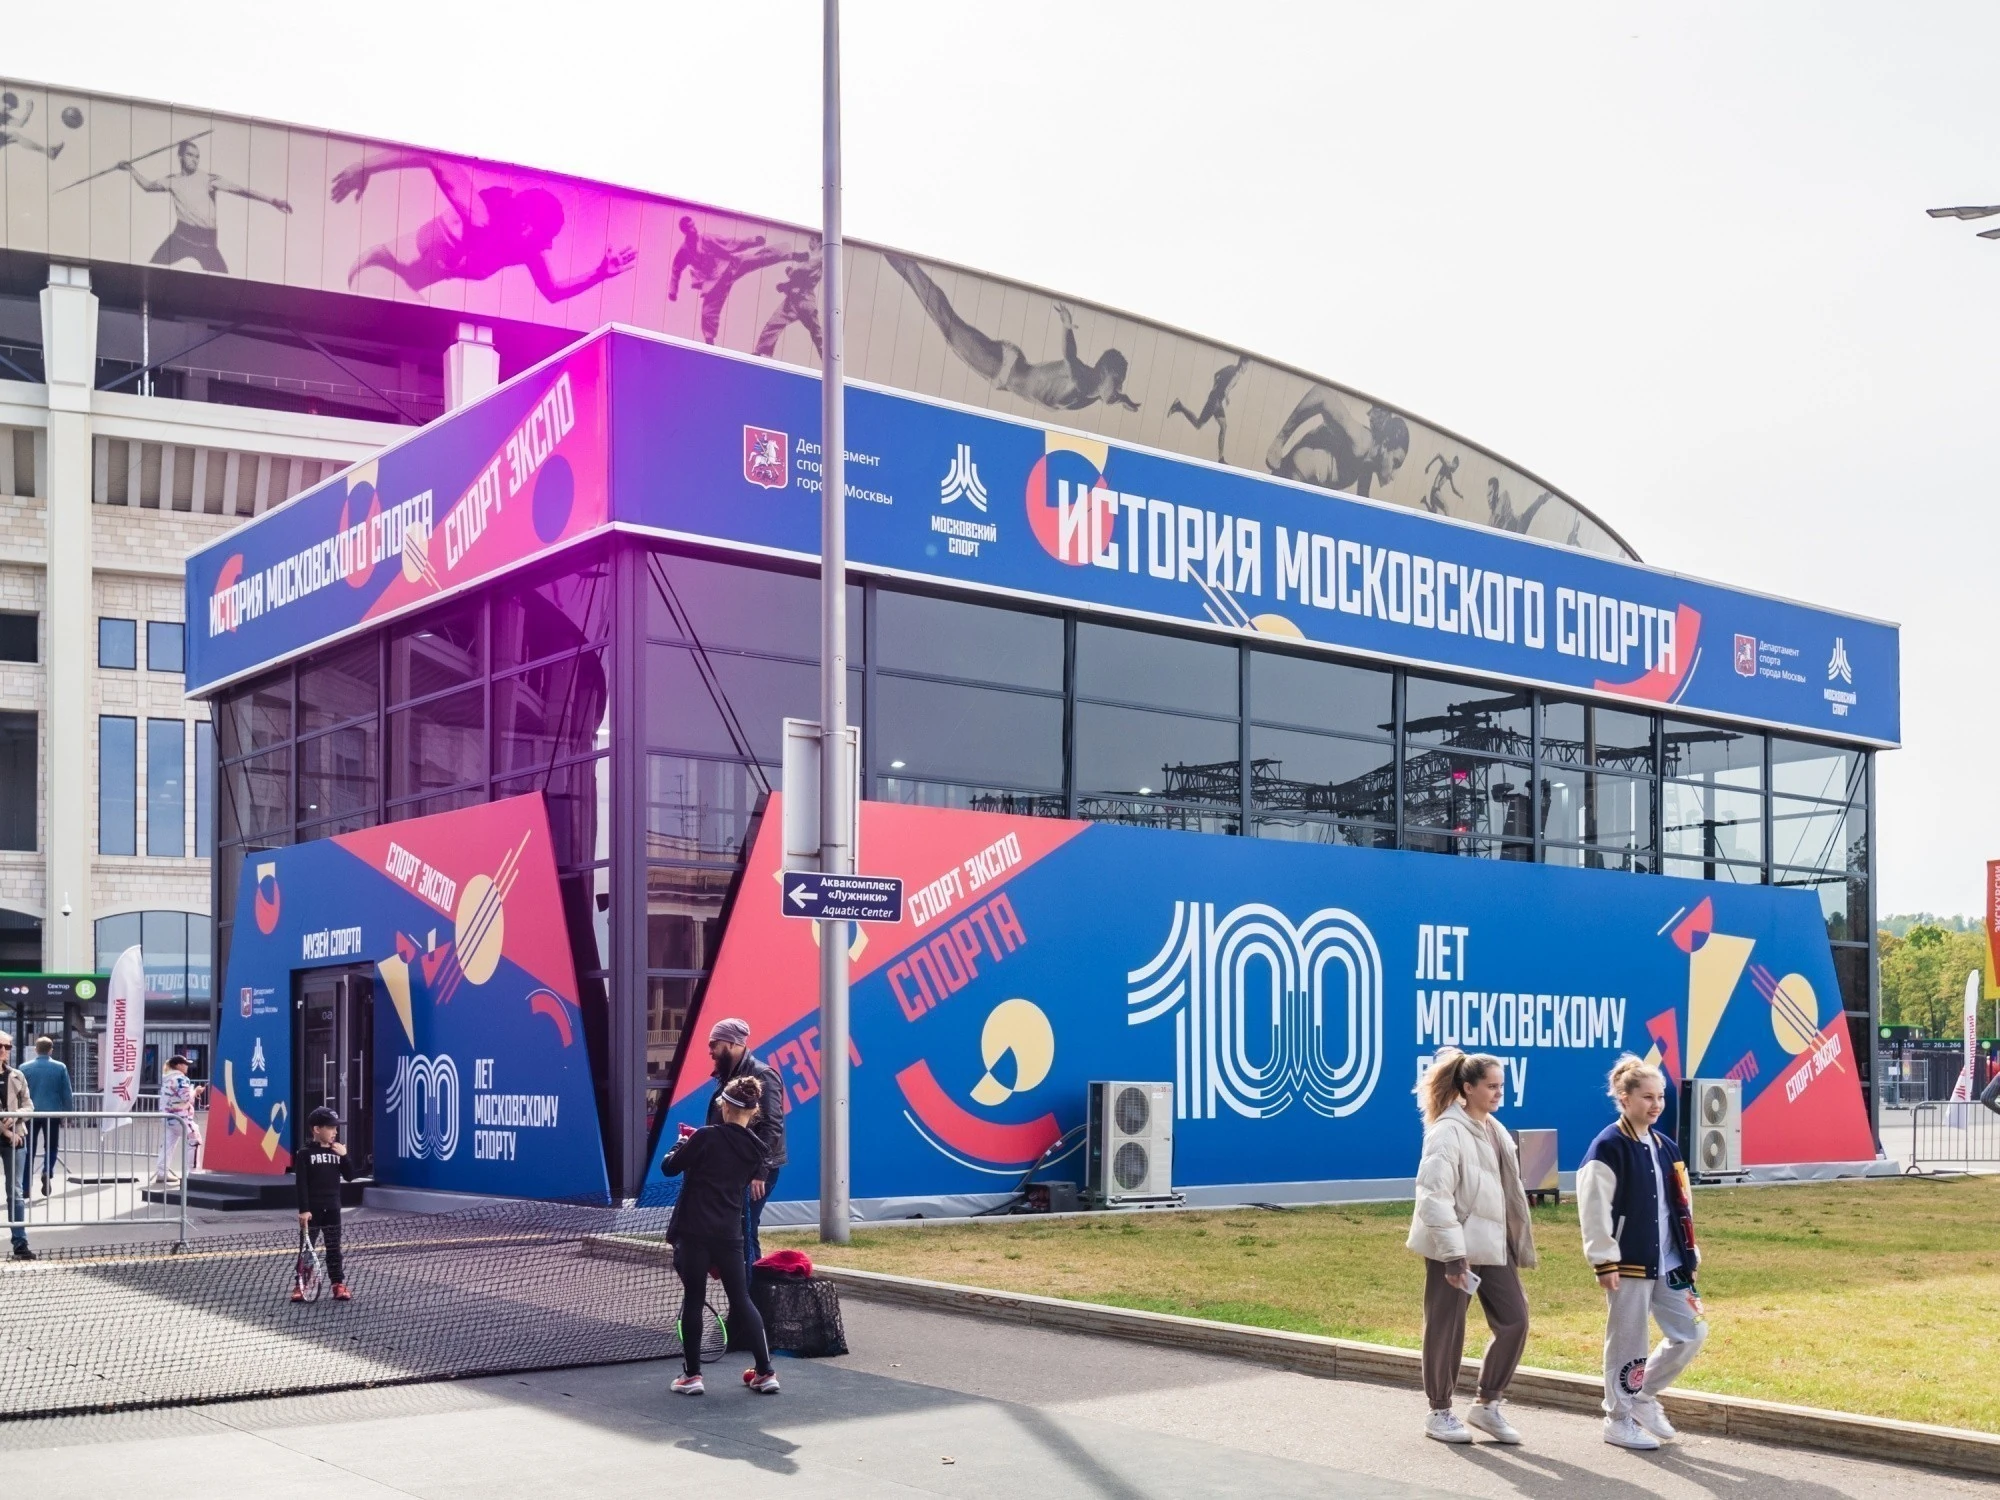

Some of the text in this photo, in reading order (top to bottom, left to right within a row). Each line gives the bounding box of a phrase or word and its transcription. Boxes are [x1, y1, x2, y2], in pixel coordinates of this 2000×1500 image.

[796, 439, 880, 467] Депамент
[445, 371, 575, 571] СПОРТ ЭКСПО
[844, 484, 893, 505] Москвы
[931, 515, 997, 542] МОСКОВСКИЙ
[210, 489, 433, 638] ИСТОРИЯ МОСКОВСКОГО СПОРТА
[949, 537, 979, 557] СПОРТ
[1058, 479, 1676, 675] ИСТОРИЯ МОСКОВСКОГО СПОРТА
[1759, 640, 1799, 657] Департамент
[1759, 655, 1780, 666] спорта
[1759, 668, 1806, 683] города Москвы
[386, 842, 456, 912] СПОРТ ЭКСПО
[820, 877, 896, 890] Аквакомплекс
[908, 832, 1022, 927] СПОРТ ЭКСПО
[822, 905, 893, 918] Aquatic Center
[828, 890, 888, 902] «Лужники»
[303, 926, 361, 960] МУЗЕЙ СПОРТА
[887, 892, 1027, 1022] СПОРТА
[1416, 924, 1469, 981] ЛЕТ
[1128, 901, 1382, 1119] 100
[1416, 989, 1626, 1048] МОСКОВСКОМУ
[113, 998, 126, 1073] МОСКОВСКИЙ
[126, 1038, 137, 1071] СПОРТ
[475, 1059, 494, 1089] ЛЕТ
[1786, 1060, 1813, 1104] СПОРТ
[386, 1054, 459, 1161] 100
[475, 1094, 558, 1127] МОСКОВСКОМУ
[310, 1153, 341, 1165] PRETTY
[475, 1130, 516, 1160] СПОРТУ
